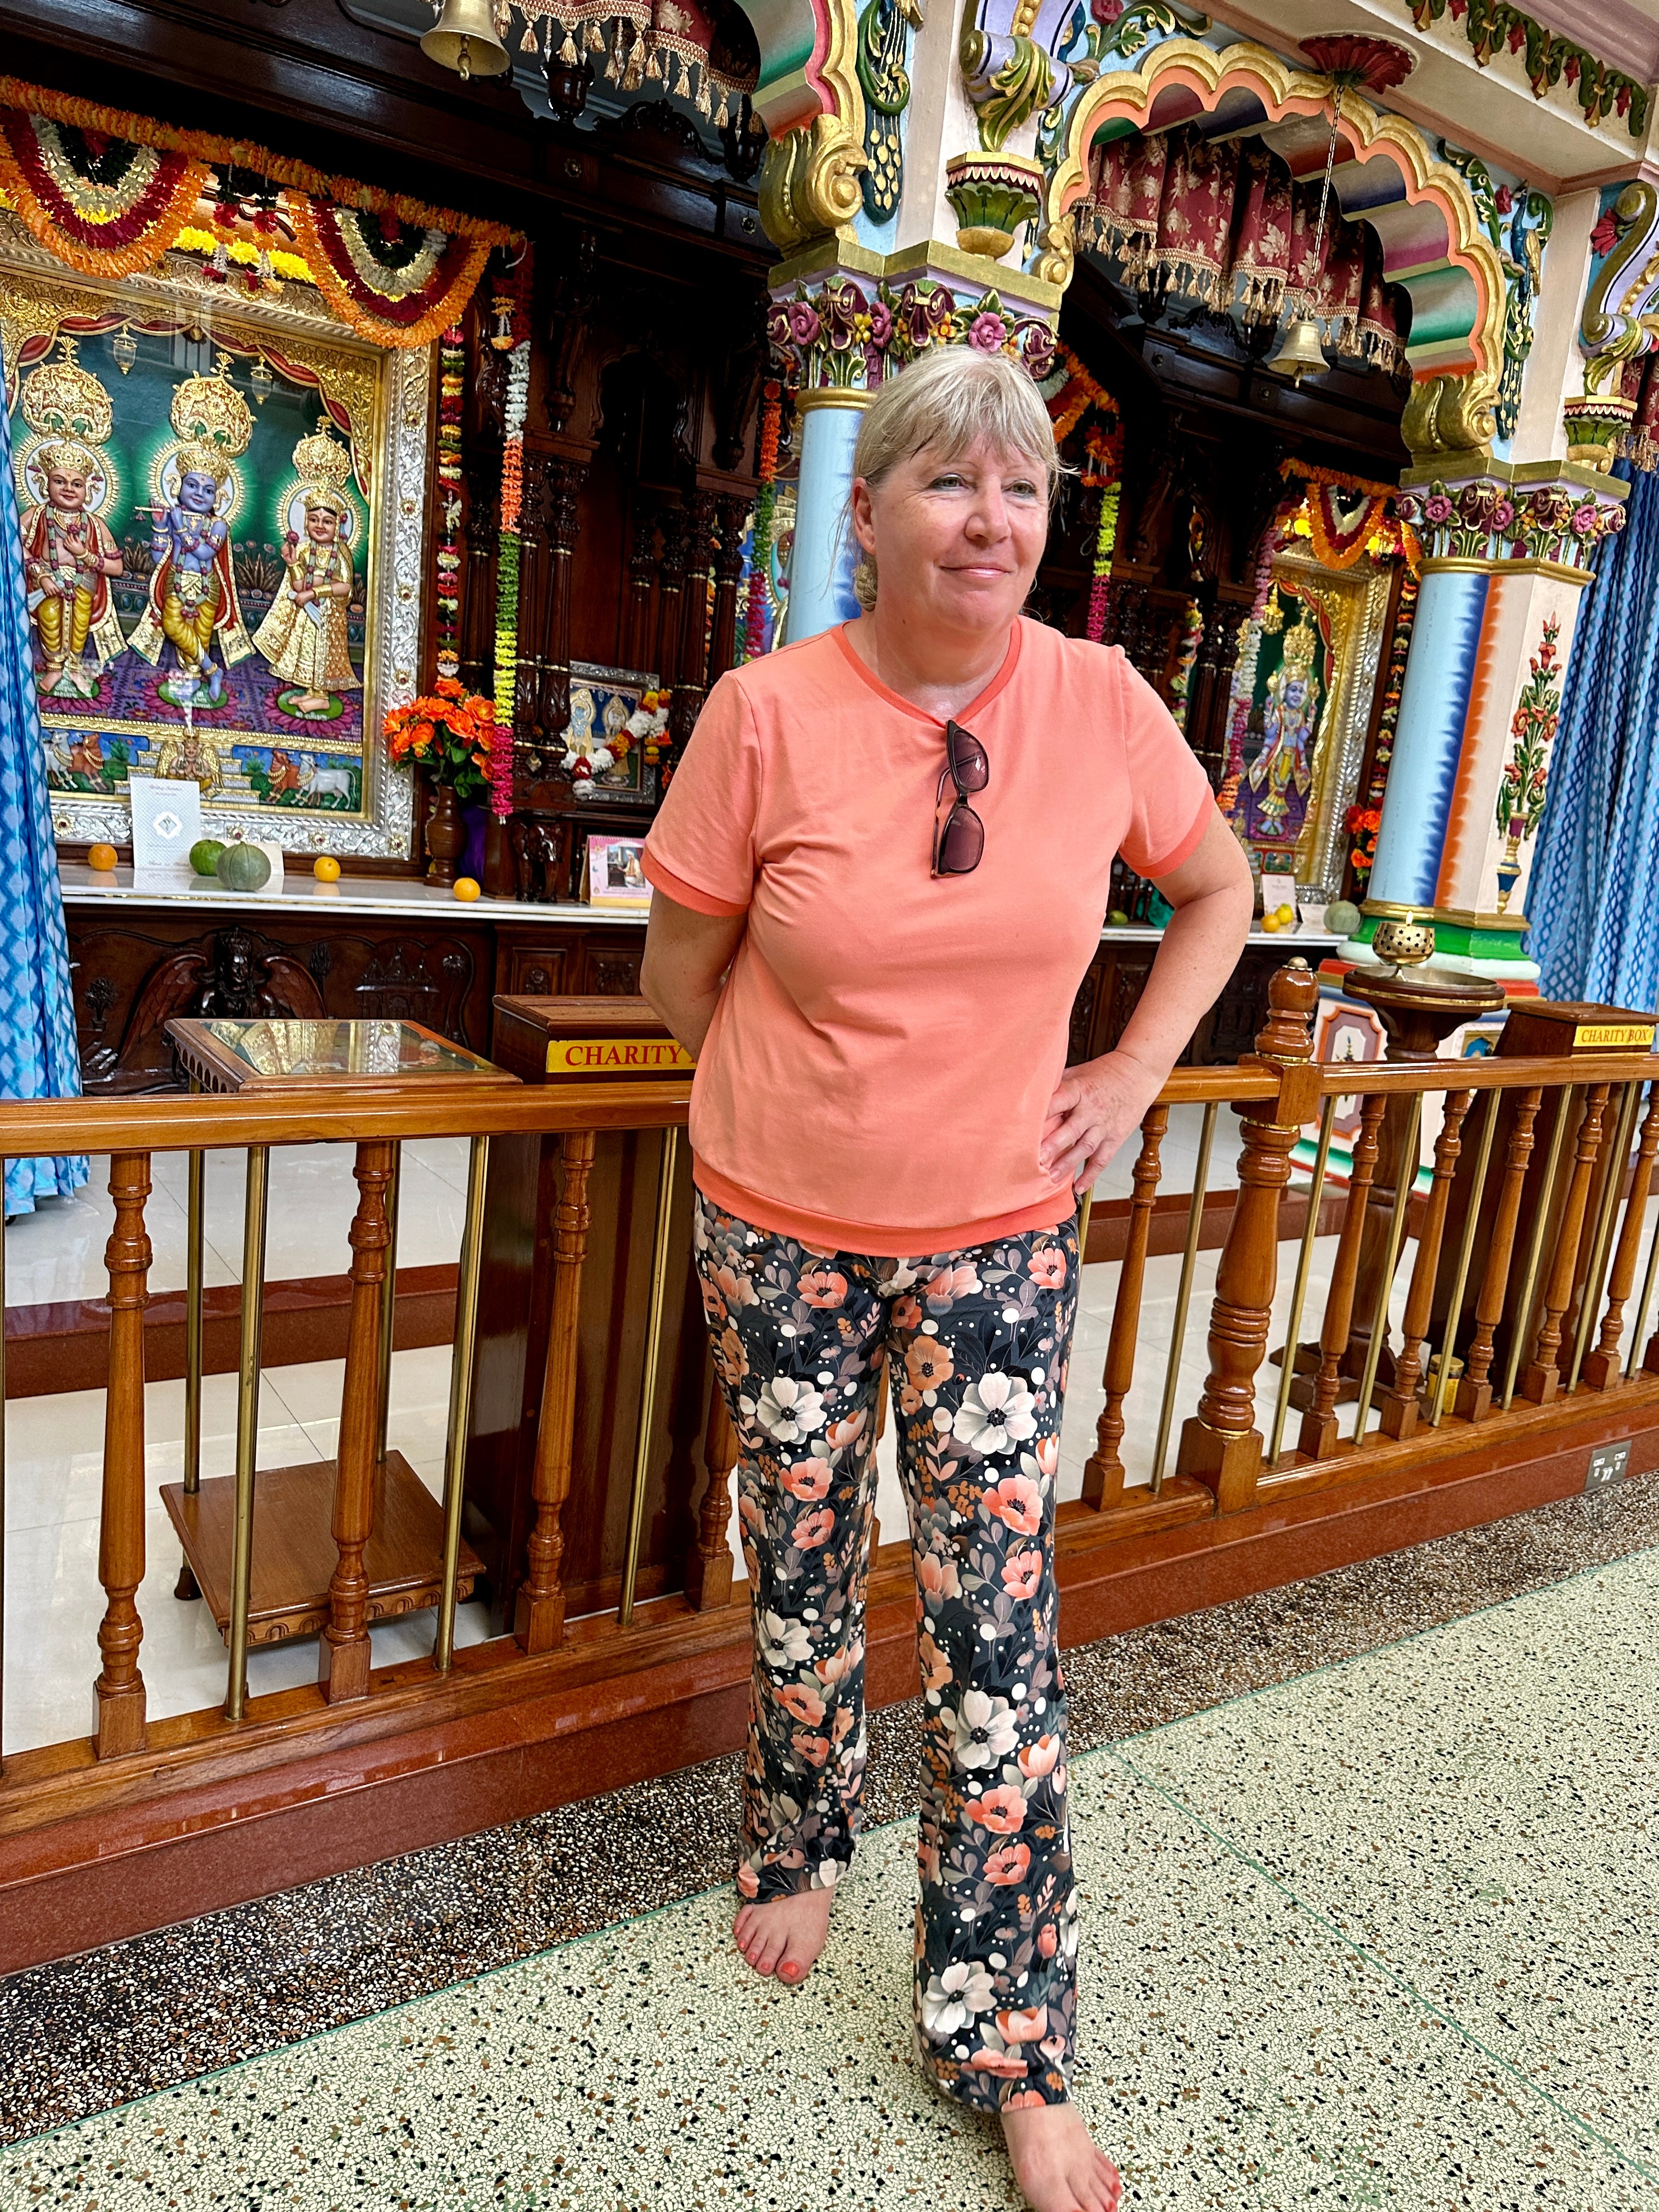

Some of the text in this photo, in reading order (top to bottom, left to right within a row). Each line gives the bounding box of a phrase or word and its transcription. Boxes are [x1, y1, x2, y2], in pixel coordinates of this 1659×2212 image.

[1581, 1029, 1649, 1042] CHARITY BOX
[565, 1045, 682, 1066] CHARITY
